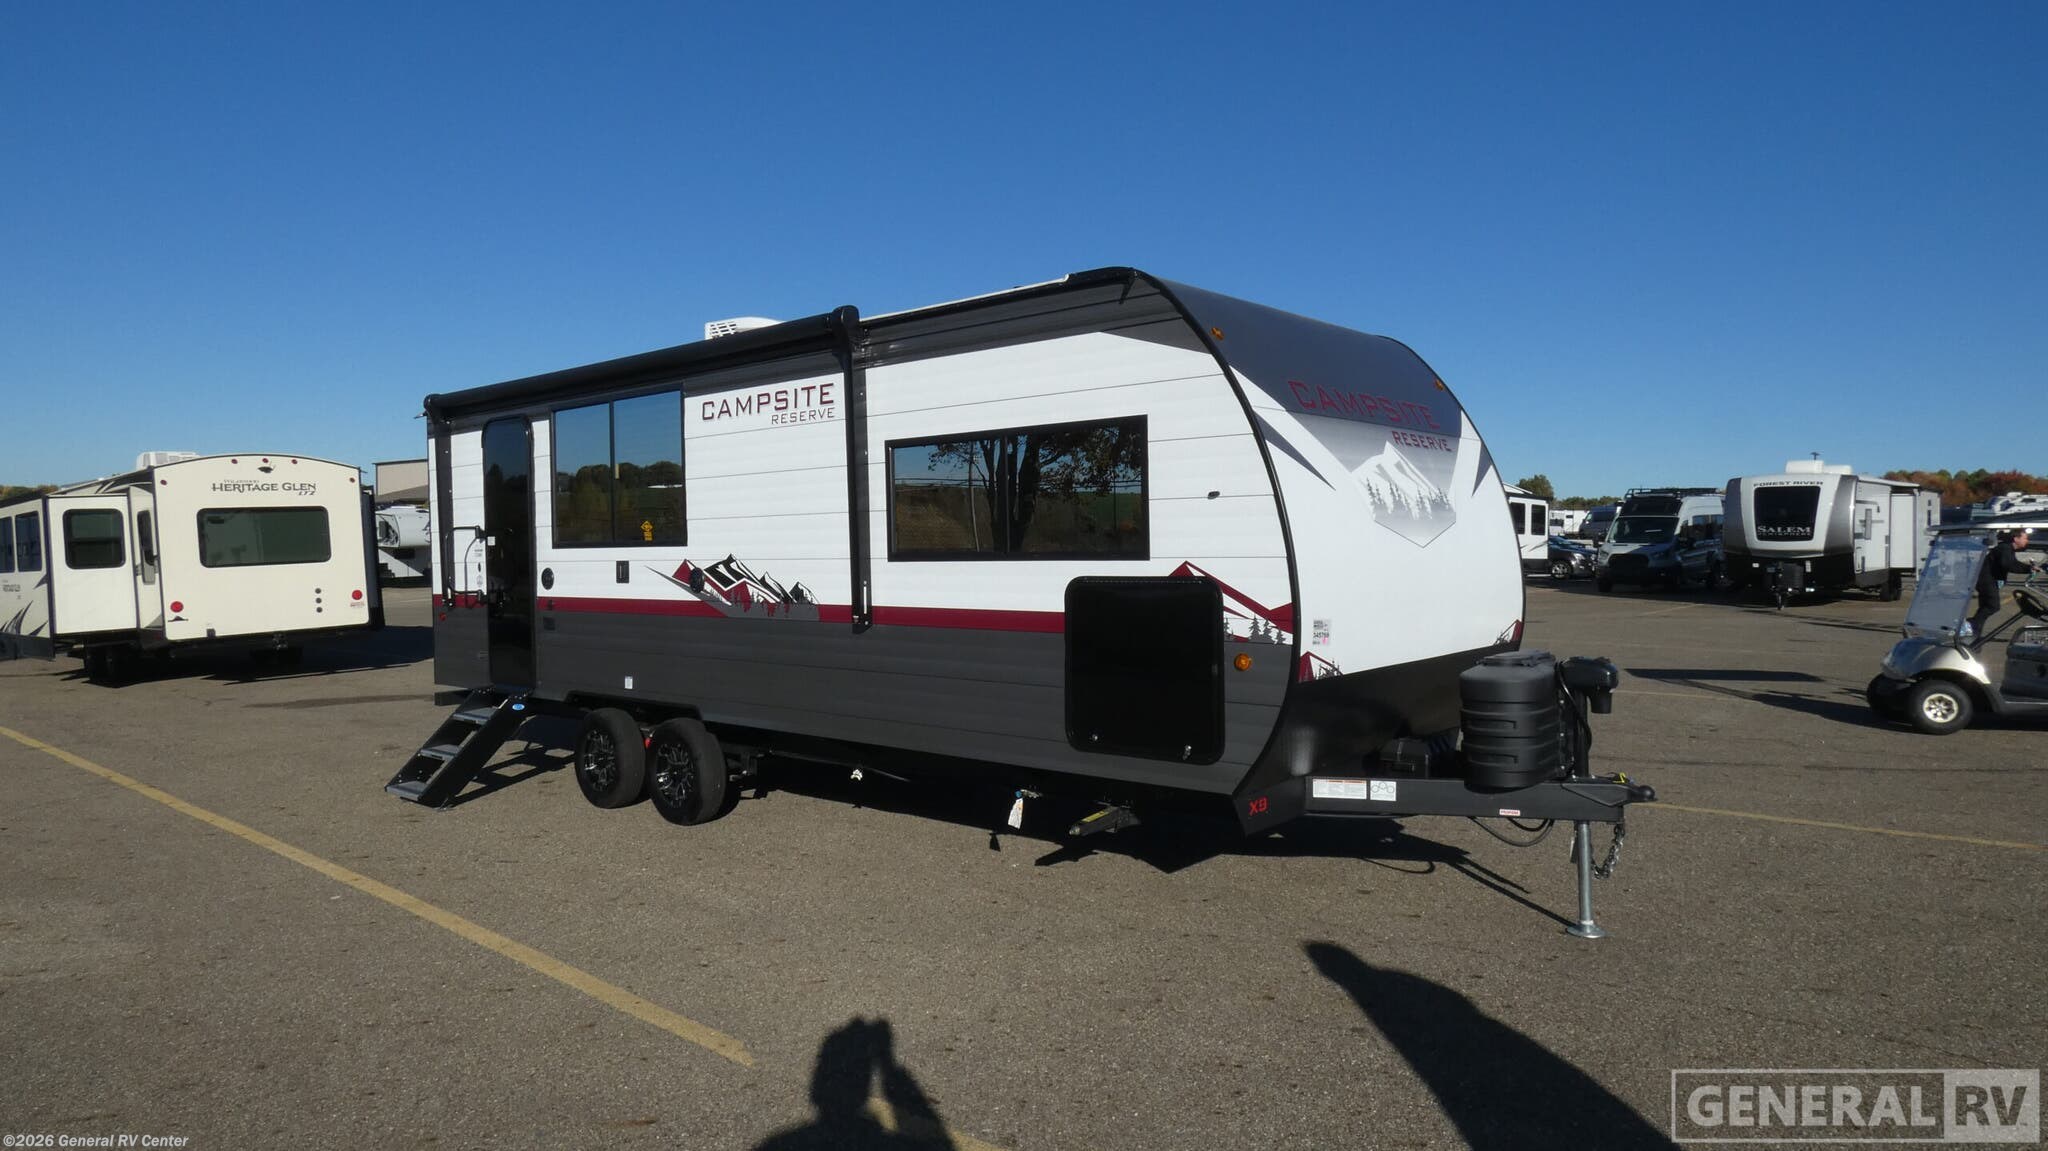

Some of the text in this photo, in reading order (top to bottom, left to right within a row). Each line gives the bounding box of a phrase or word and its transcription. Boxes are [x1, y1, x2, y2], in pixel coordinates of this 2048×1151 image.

[702, 382, 834, 420] CAMPSITE
[1288, 380, 1440, 429] CAMPSITE
[771, 407, 836, 424] RESERVE
[1391, 430, 1453, 452] RESERVE
[212, 482, 316, 493] HERITAGE GLEN
[1757, 525, 1811, 533] SALEM
